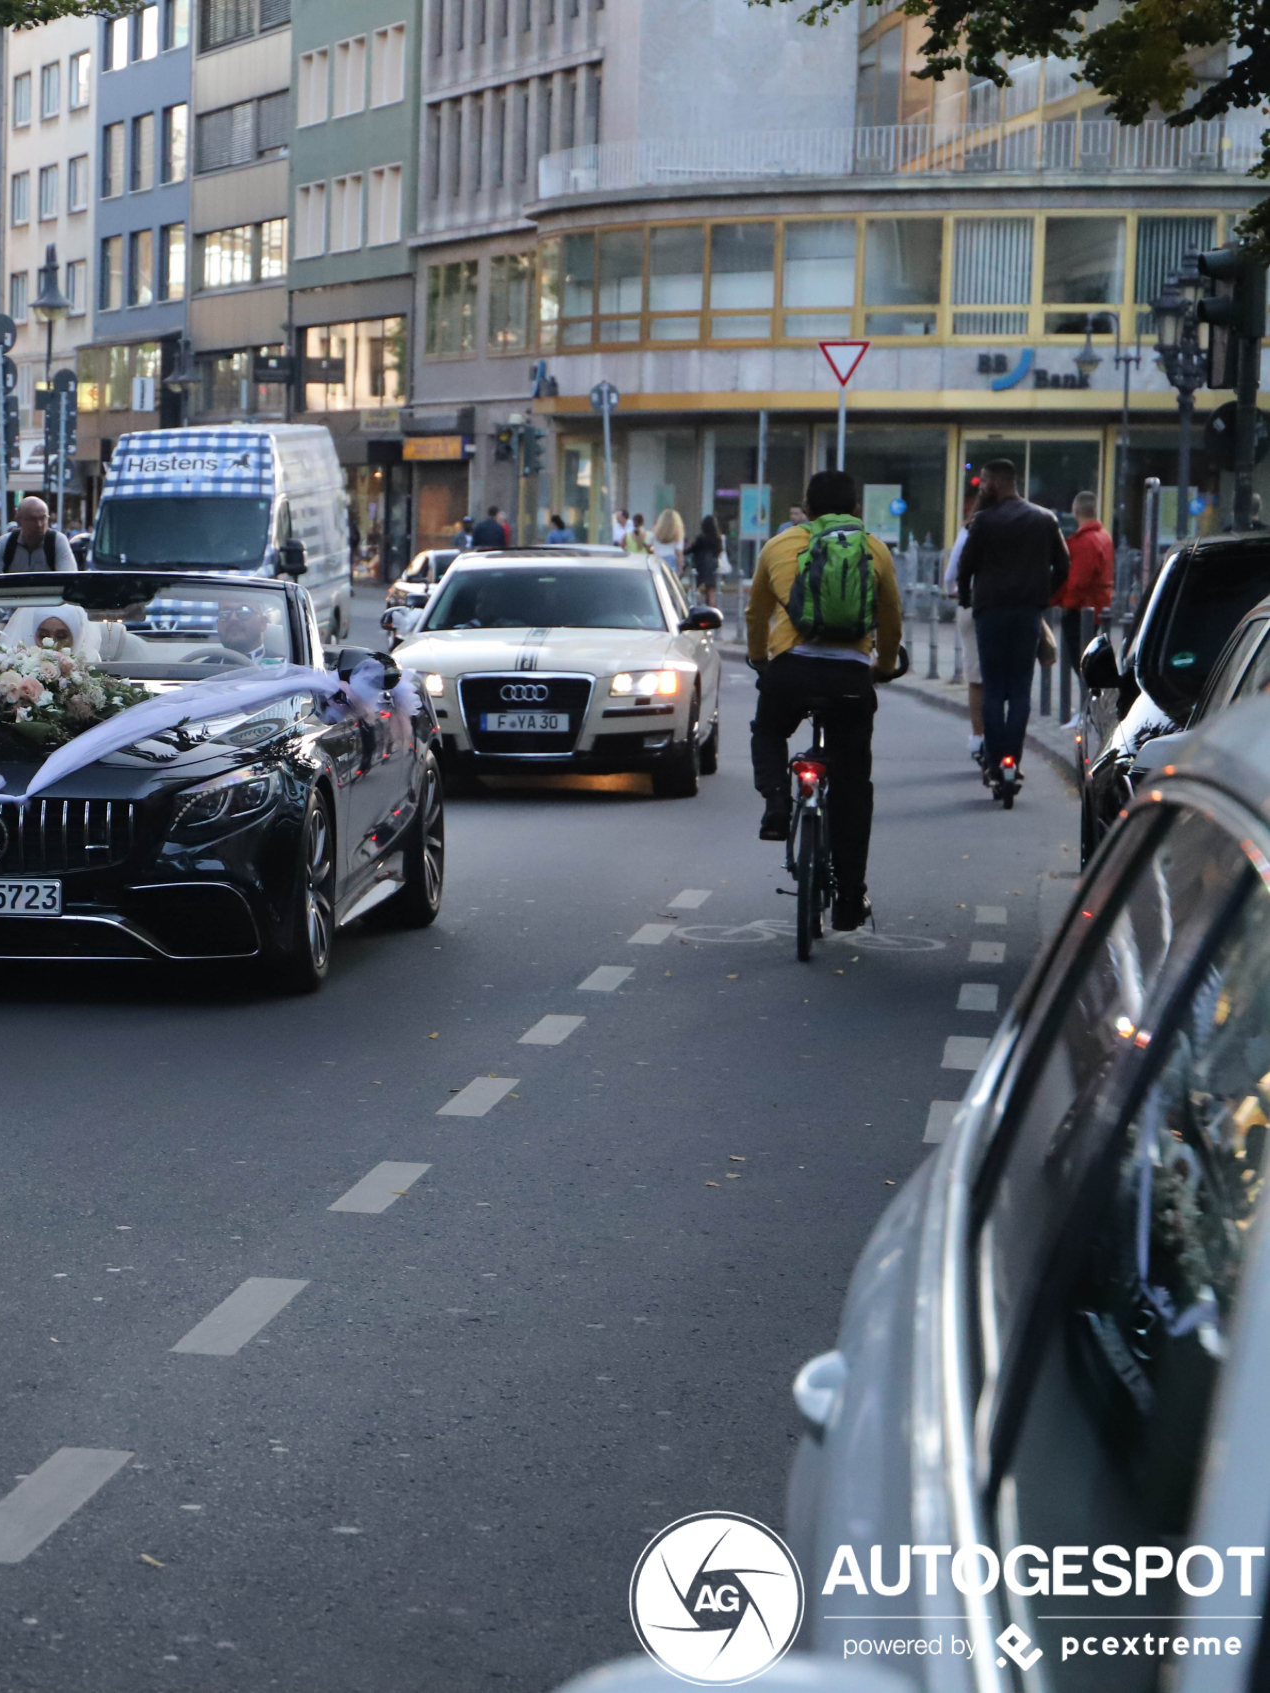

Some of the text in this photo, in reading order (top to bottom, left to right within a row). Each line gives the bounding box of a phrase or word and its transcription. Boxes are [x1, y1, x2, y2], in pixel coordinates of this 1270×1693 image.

[1033, 368, 1090, 390] Bank
[127, 456, 218, 473] Hästens
[497, 715, 507, 728] F
[517, 715, 536, 729] YA
[540, 715, 558, 729] 30
